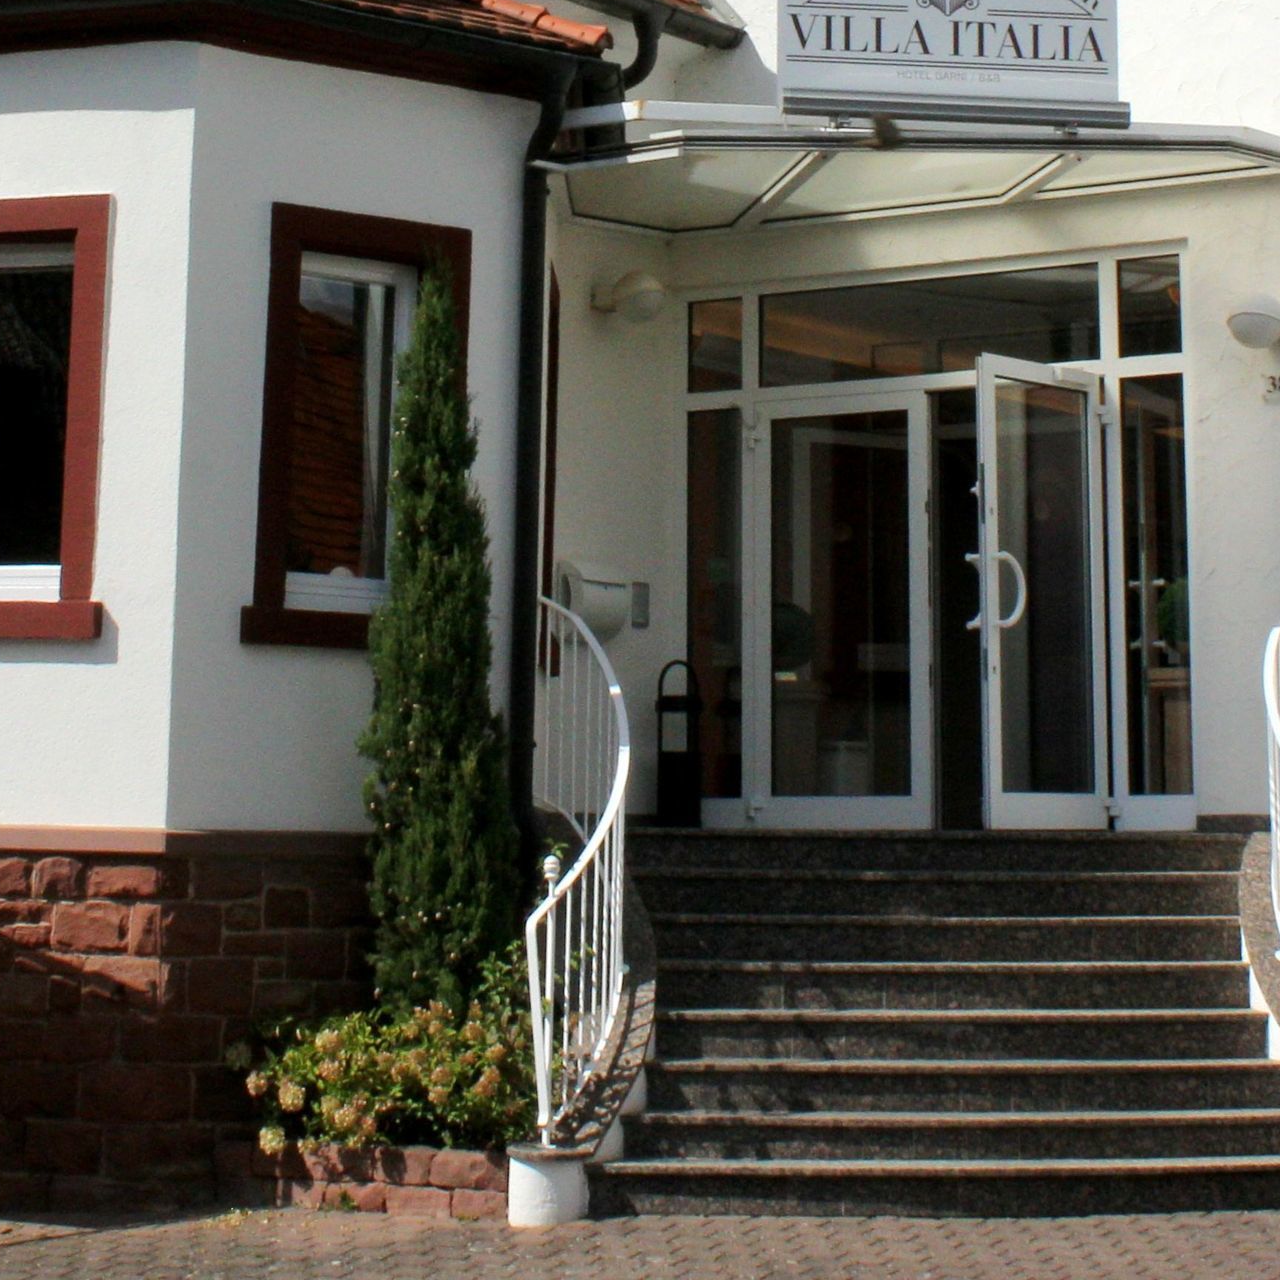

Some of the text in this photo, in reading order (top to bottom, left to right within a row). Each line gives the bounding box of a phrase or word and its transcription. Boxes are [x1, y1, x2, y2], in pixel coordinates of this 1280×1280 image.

[787, 12, 1108, 63] VILLA ITALIA
[896, 70, 931, 81] HOTEL
